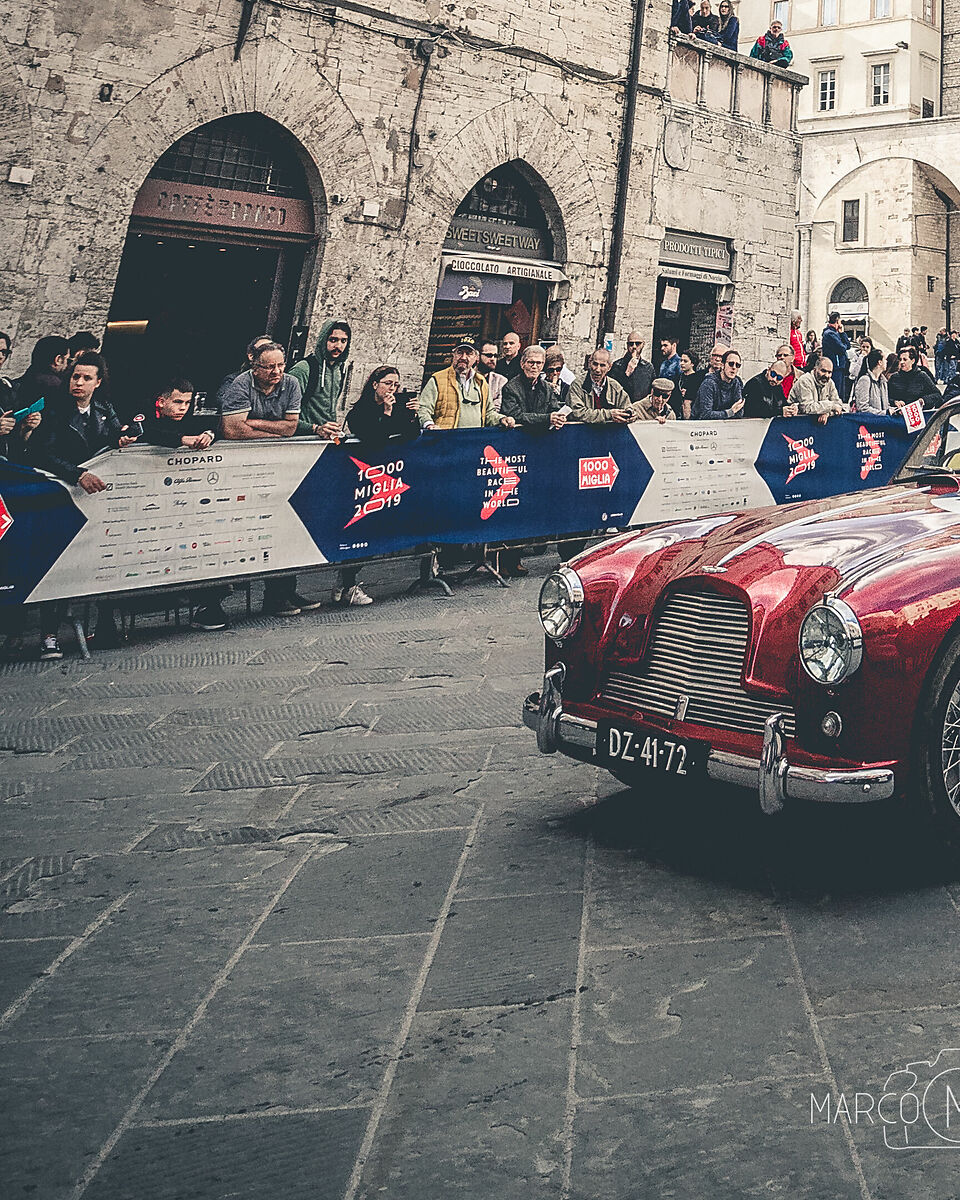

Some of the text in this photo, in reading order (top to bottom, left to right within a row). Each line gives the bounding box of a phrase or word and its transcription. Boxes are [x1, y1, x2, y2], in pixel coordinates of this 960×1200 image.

[664, 240, 726, 259] PRODOTTI TIPICI
[451, 260, 553, 280] CIOCCOLATO ARTIGIANALE
[661, 268, 677, 276] Salami
[911, 403, 920, 422] 1000
[788, 436, 814, 452] 1000
[167, 455, 223, 466] CHOPARD
[480, 455, 526, 465] THE MOST
[789, 449, 816, 465] MIGLIA
[357, 460, 404, 482] 1000
[476, 464, 528, 476] BEAUTIFUL
[582, 460, 609, 472] 1000
[788, 460, 816, 478] 2019
[487, 477, 517, 487] RACE
[581, 473, 611, 486] MIGLIA
[354, 477, 403, 500] MIGLIA
[484, 487, 519, 497] IN THE
[353, 494, 401, 517] 2019
[482, 498, 520, 509] WORLD
